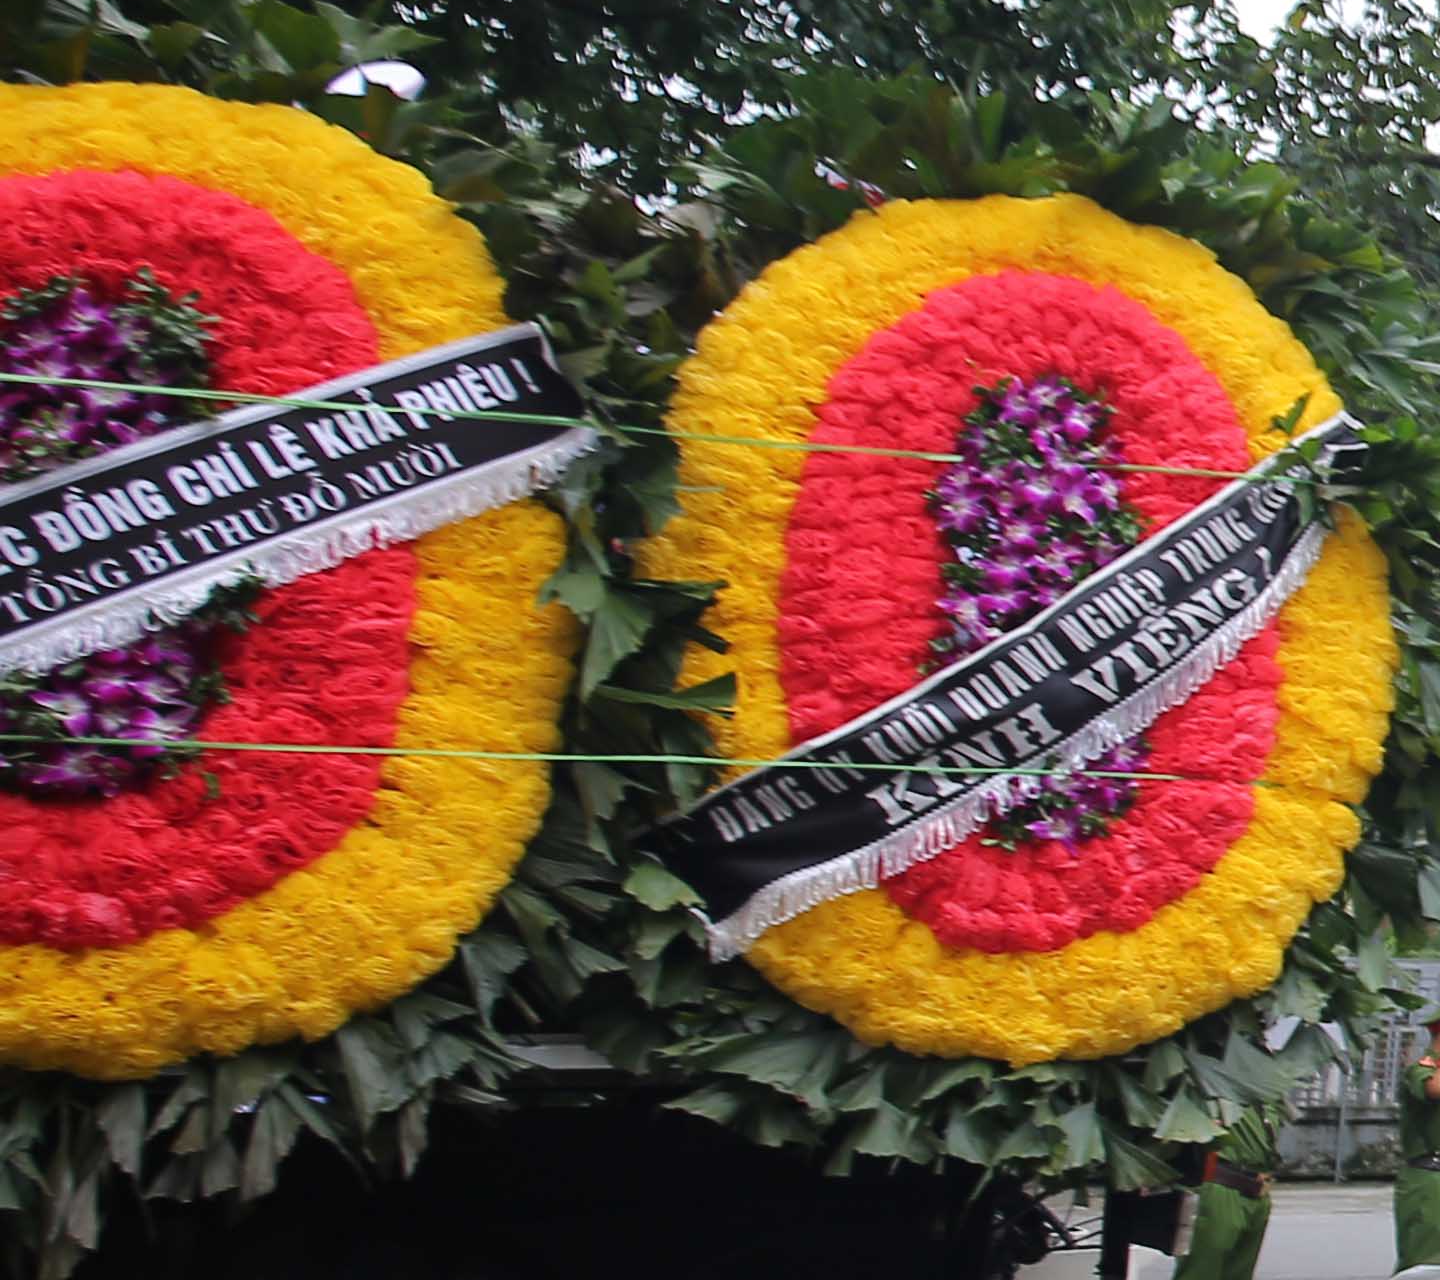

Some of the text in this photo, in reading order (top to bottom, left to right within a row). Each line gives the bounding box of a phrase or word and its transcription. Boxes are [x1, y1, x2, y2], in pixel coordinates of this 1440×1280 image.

[0, 526, 39, 573] C
[31, 486, 177, 553] ĐỒNG
[166, 441, 259, 506] CHÍ
[246, 424, 319, 479] LÊ
[304, 387, 407, 460] KHẢ
[392, 363, 519, 430] PHIÊU
[1, 442, 463, 622] TỔNG BÍ THƯ ĐỖ MƯỜI
[1159, 508, 1257, 583] TRUNG
[1069, 568, 1258, 703] VIẾNG
